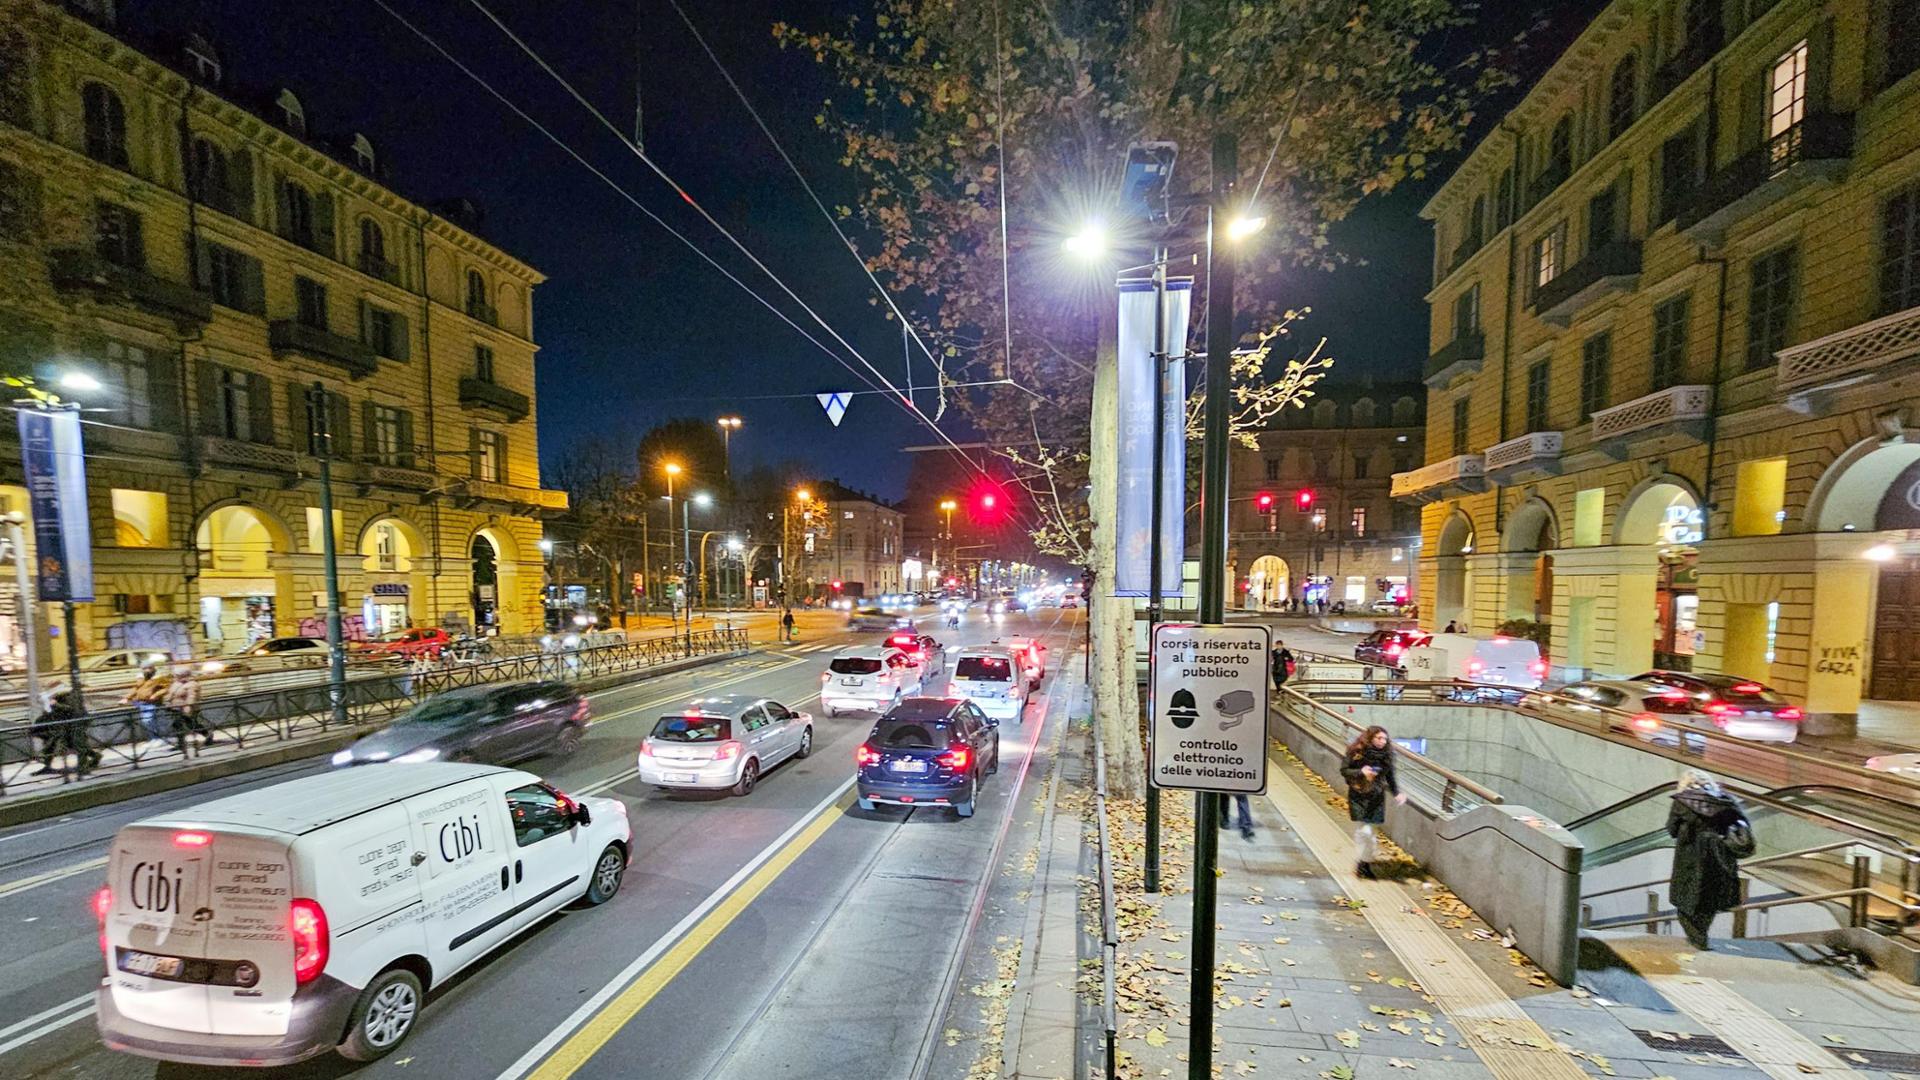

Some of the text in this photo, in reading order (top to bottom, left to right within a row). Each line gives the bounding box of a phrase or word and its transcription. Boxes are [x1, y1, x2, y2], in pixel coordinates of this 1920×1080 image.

[1161, 639, 1262, 650] corsia riservata
[1172, 653, 1184, 662] al
[1821, 646, 1860, 659] VIVA
[1182, 667, 1239, 678] pubblico
[1815, 659, 1855, 676] GAZA
[1179, 740, 1238, 751] controllo
[1173, 752, 1244, 764] elettronico
[1161, 765, 1256, 780] delle violazioni
[439, 815, 482, 862] Cibi
[131, 861, 183, 914] Cibi
